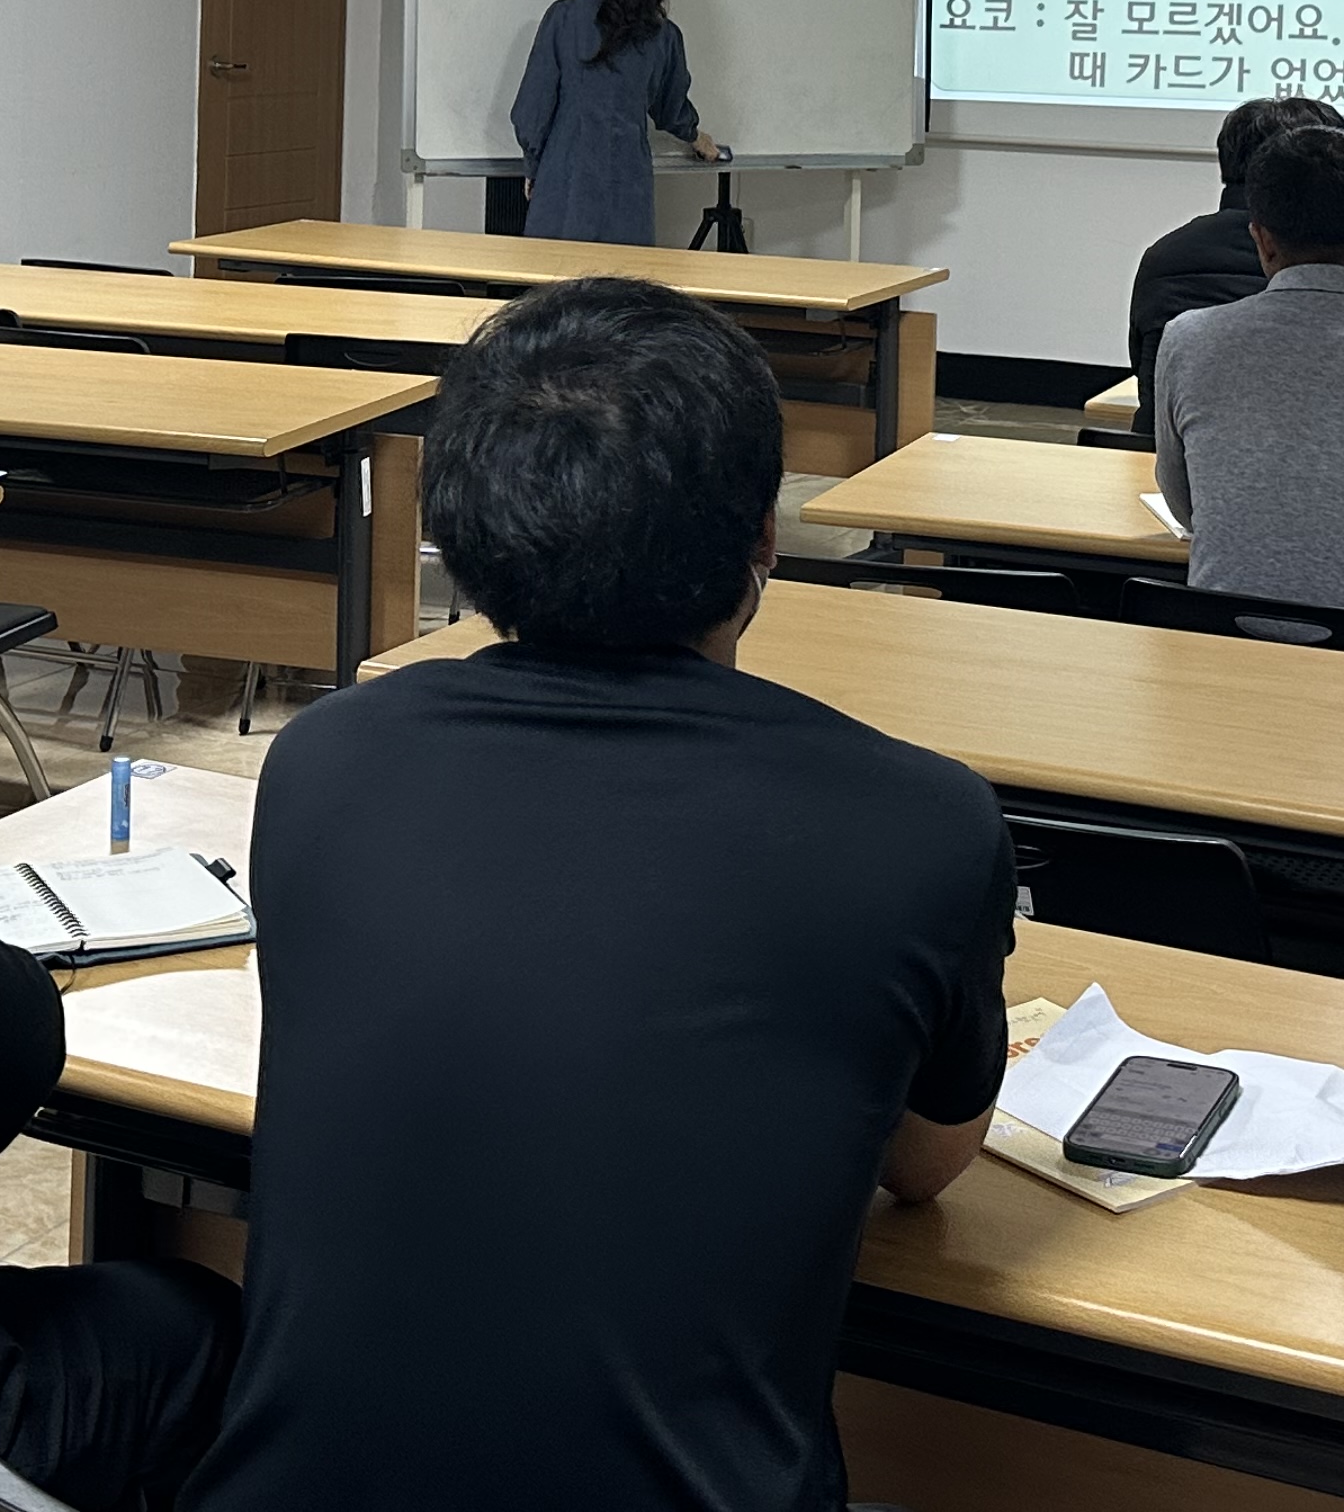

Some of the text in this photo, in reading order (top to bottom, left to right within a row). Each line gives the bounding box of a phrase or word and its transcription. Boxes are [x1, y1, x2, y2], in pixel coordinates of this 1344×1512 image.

[1063, 0, 1105, 42] 잘
[1120, 0, 1341, 47] 모르겠어요.
[1068, 51, 1107, 89] 때
[1125, 53, 1252, 93] 카드가
